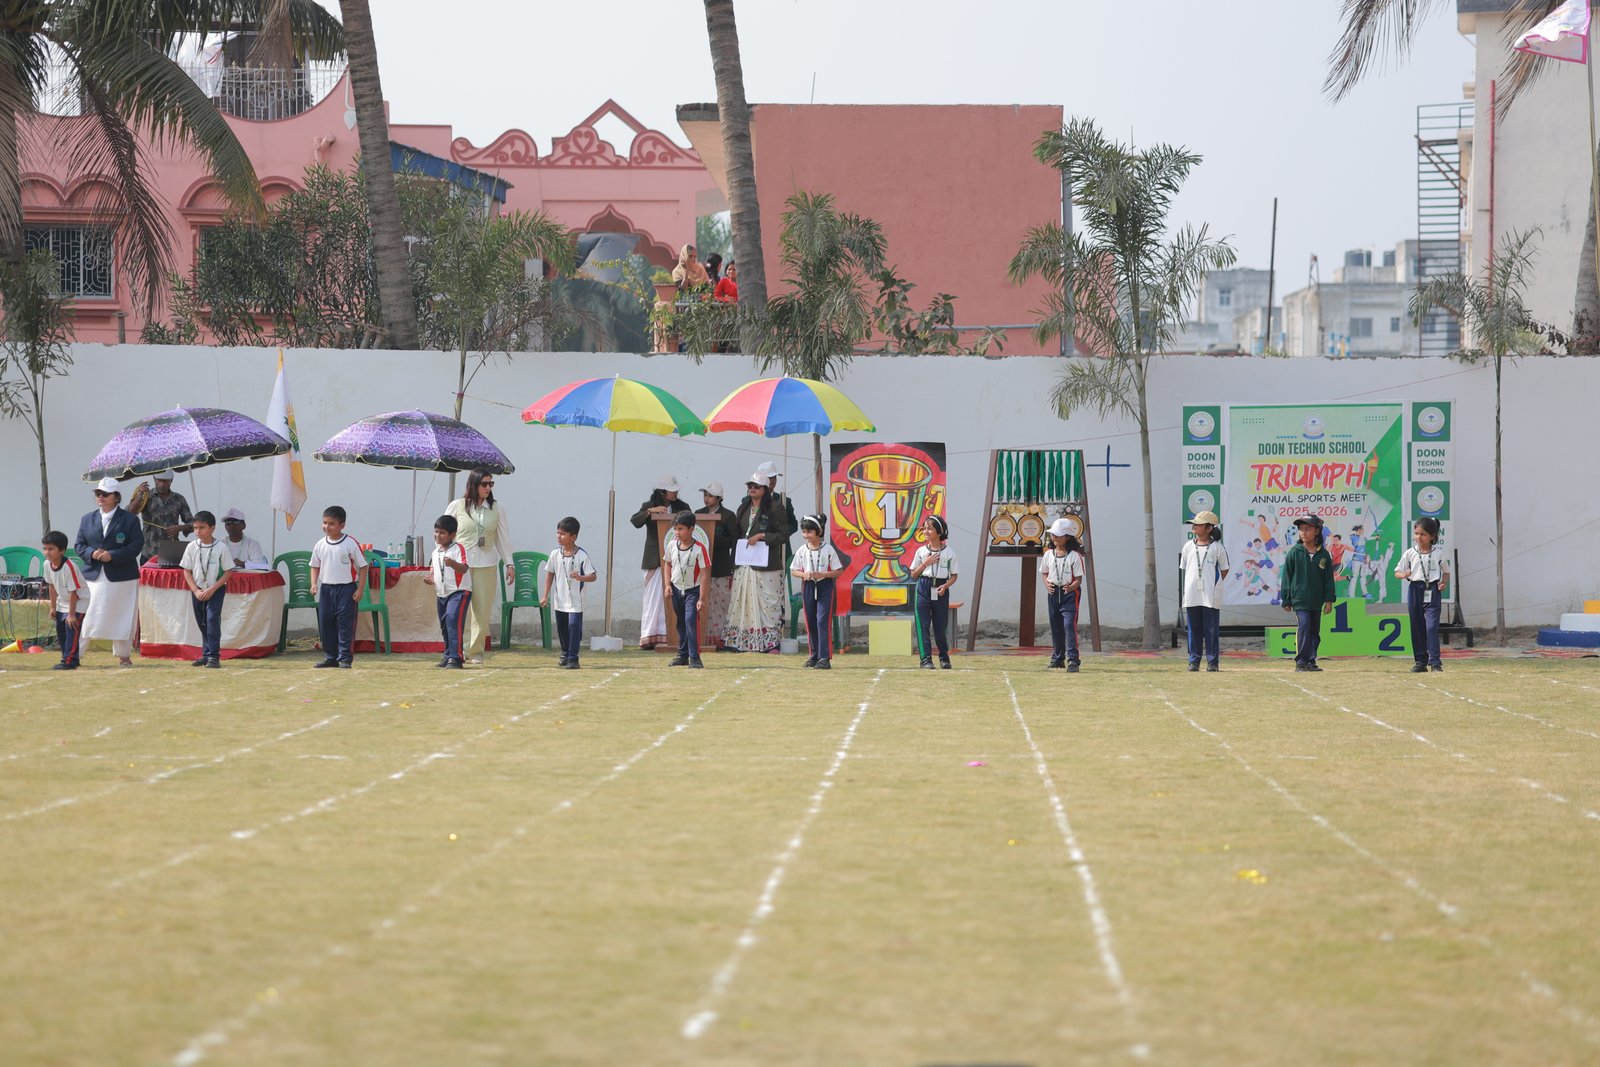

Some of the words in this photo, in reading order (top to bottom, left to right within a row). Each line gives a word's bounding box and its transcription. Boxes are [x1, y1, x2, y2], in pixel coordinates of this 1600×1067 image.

[1258, 443, 1285, 455] DOON
[1288, 442, 1326, 455] TECHNO
[1329, 441, 1367, 454] SCHOOL
[1417, 449, 1446, 458] DOON
[1187, 452, 1216, 461] DOON
[1250, 461, 1366, 492] TRIUMPH
[1252, 495, 1294, 503] ANNUAL
[1297, 494, 1337, 503] SPORTS
[1340, 493, 1368, 502] MEET
[877, 491, 901, 540] 1
[1279, 506, 1347, 517] 2025-2026
[1330, 601, 1353, 633] 1
[1378, 618, 1405, 651] 2
